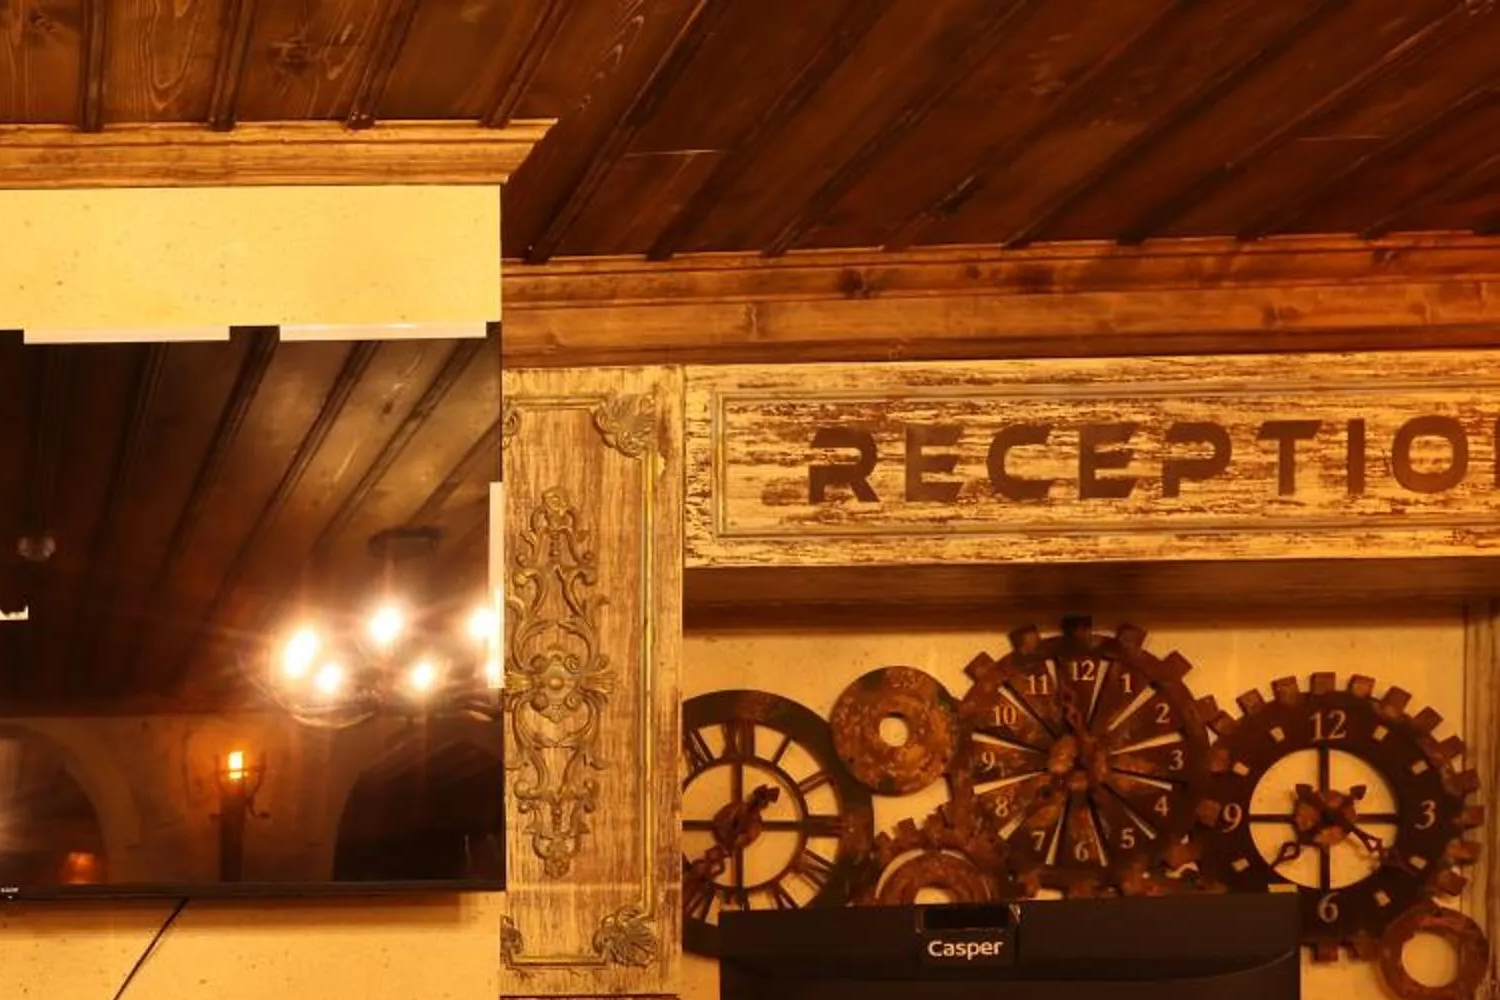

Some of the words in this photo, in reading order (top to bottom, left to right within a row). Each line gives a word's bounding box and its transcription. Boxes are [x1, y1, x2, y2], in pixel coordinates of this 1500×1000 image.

[808, 416, 1500, 504] RECEPTIO
[1071, 659, 1095, 681] 12
[1027, 674, 1049, 695] 11
[1121, 673, 1132, 693] 1
[993, 705, 1017, 726] 10
[1155, 703, 1170, 723] 2
[1309, 709, 1347, 741] 12
[981, 751, 995, 771] 9
[1168, 751, 1184, 771] 3
[994, 796, 1009, 817] 8
[1154, 796, 1169, 816] 4
[1414, 800, 1437, 830] 3
[1222, 802, 1242, 833] 9
[1031, 831, 1045, 851] 7
[1121, 827, 1135, 849] 5
[1074, 841, 1089, 861] 6
[1318, 892, 1339, 923] 6
[927, 940, 1004, 960] Casper
